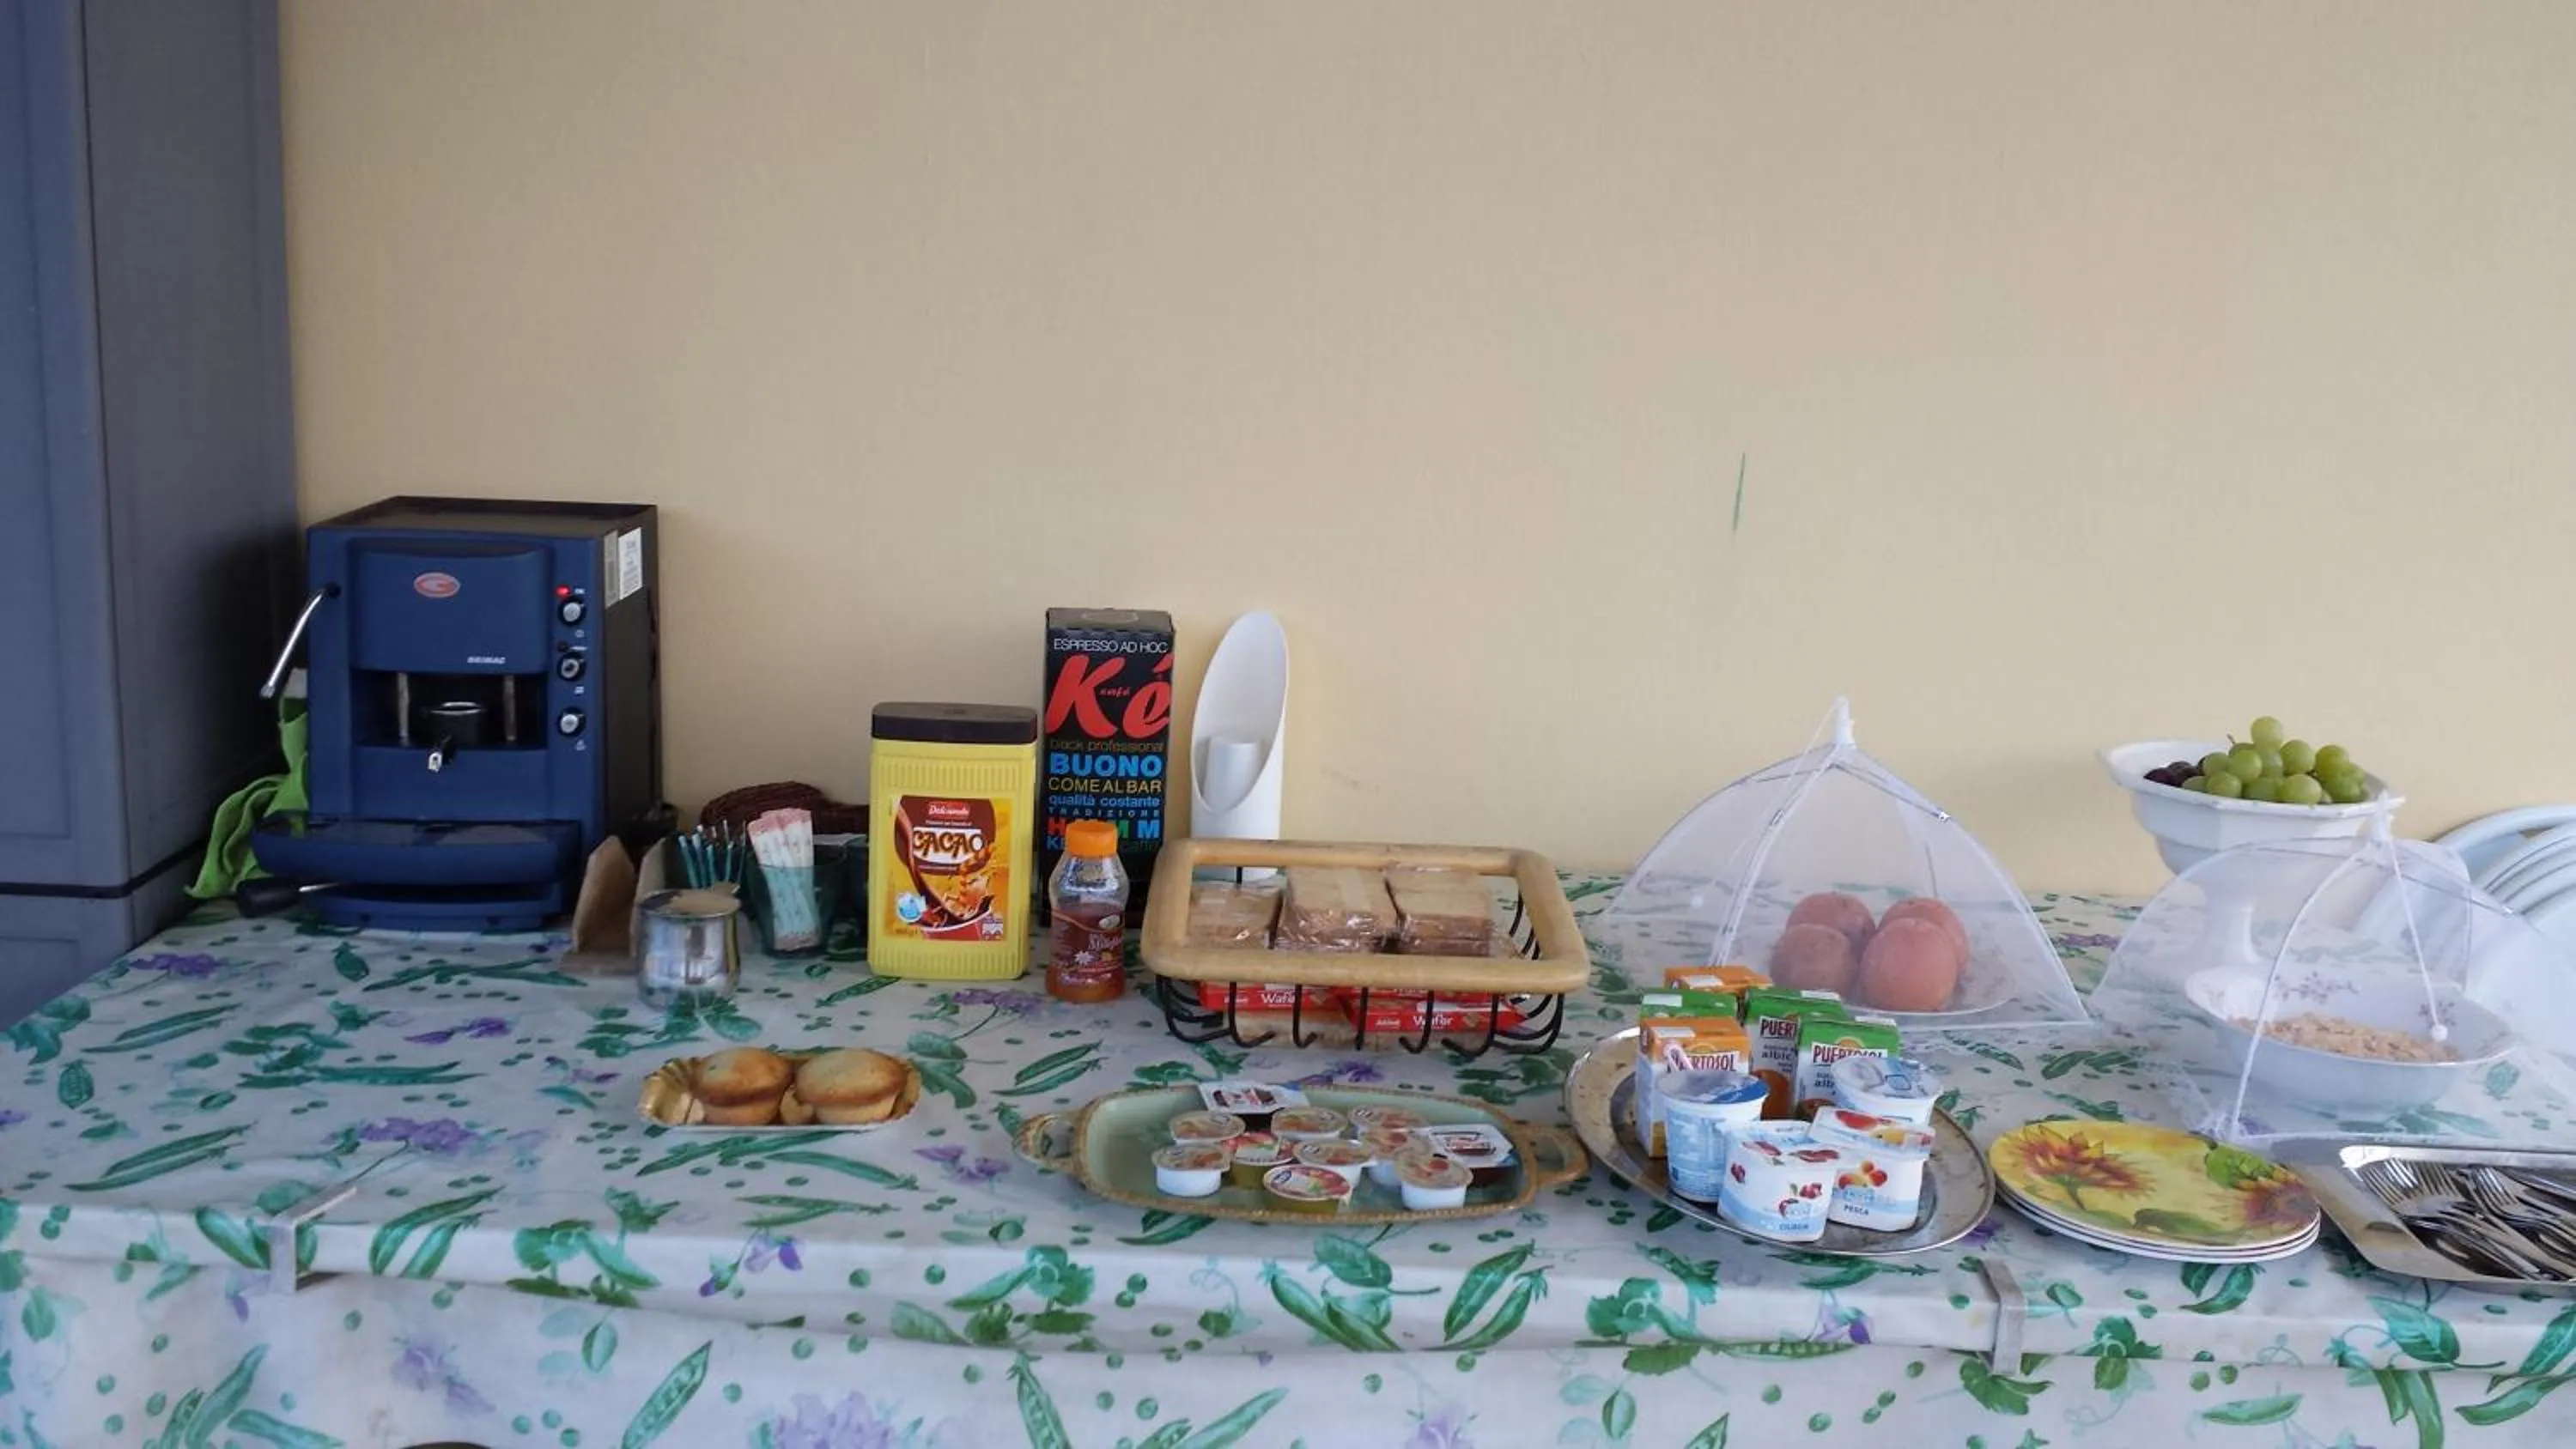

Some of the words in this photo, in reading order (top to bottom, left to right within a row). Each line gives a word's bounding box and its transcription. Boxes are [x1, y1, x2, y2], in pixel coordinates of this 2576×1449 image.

[1054, 638, 1117, 652] ESPRESSO
[1119, 641, 1138, 652] AD
[1139, 641, 1168, 653] HOC
[1049, 752, 1162, 777] BUONO
[1048, 795, 1096, 808] qualità
[1100, 796, 1160, 808] costante
[913, 830, 986, 858] CACAO
